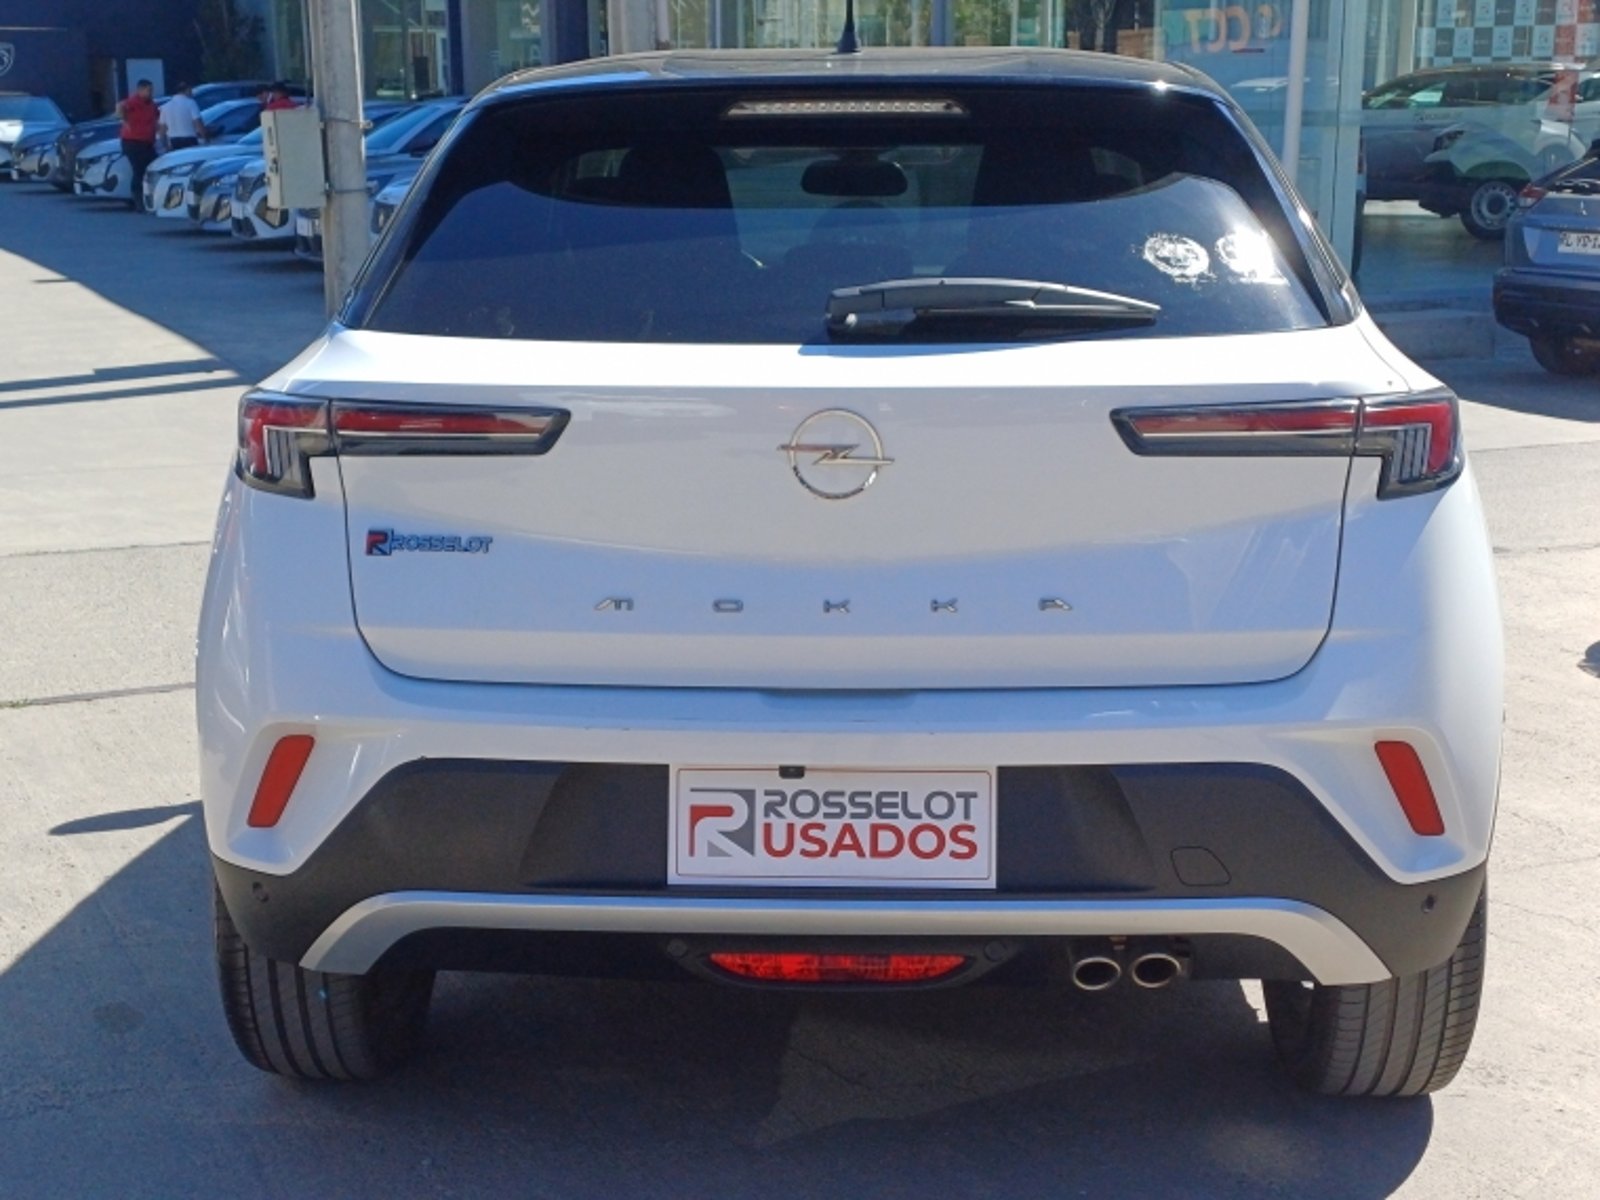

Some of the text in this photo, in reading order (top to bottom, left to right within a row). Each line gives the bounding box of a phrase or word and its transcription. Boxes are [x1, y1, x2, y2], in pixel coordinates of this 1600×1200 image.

[391, 534, 494, 554] ROSSELOT
[594, 597, 1073, 613] MOKKA
[764, 790, 978, 820] ROSSELOT
[763, 822, 979, 860] USADOS
